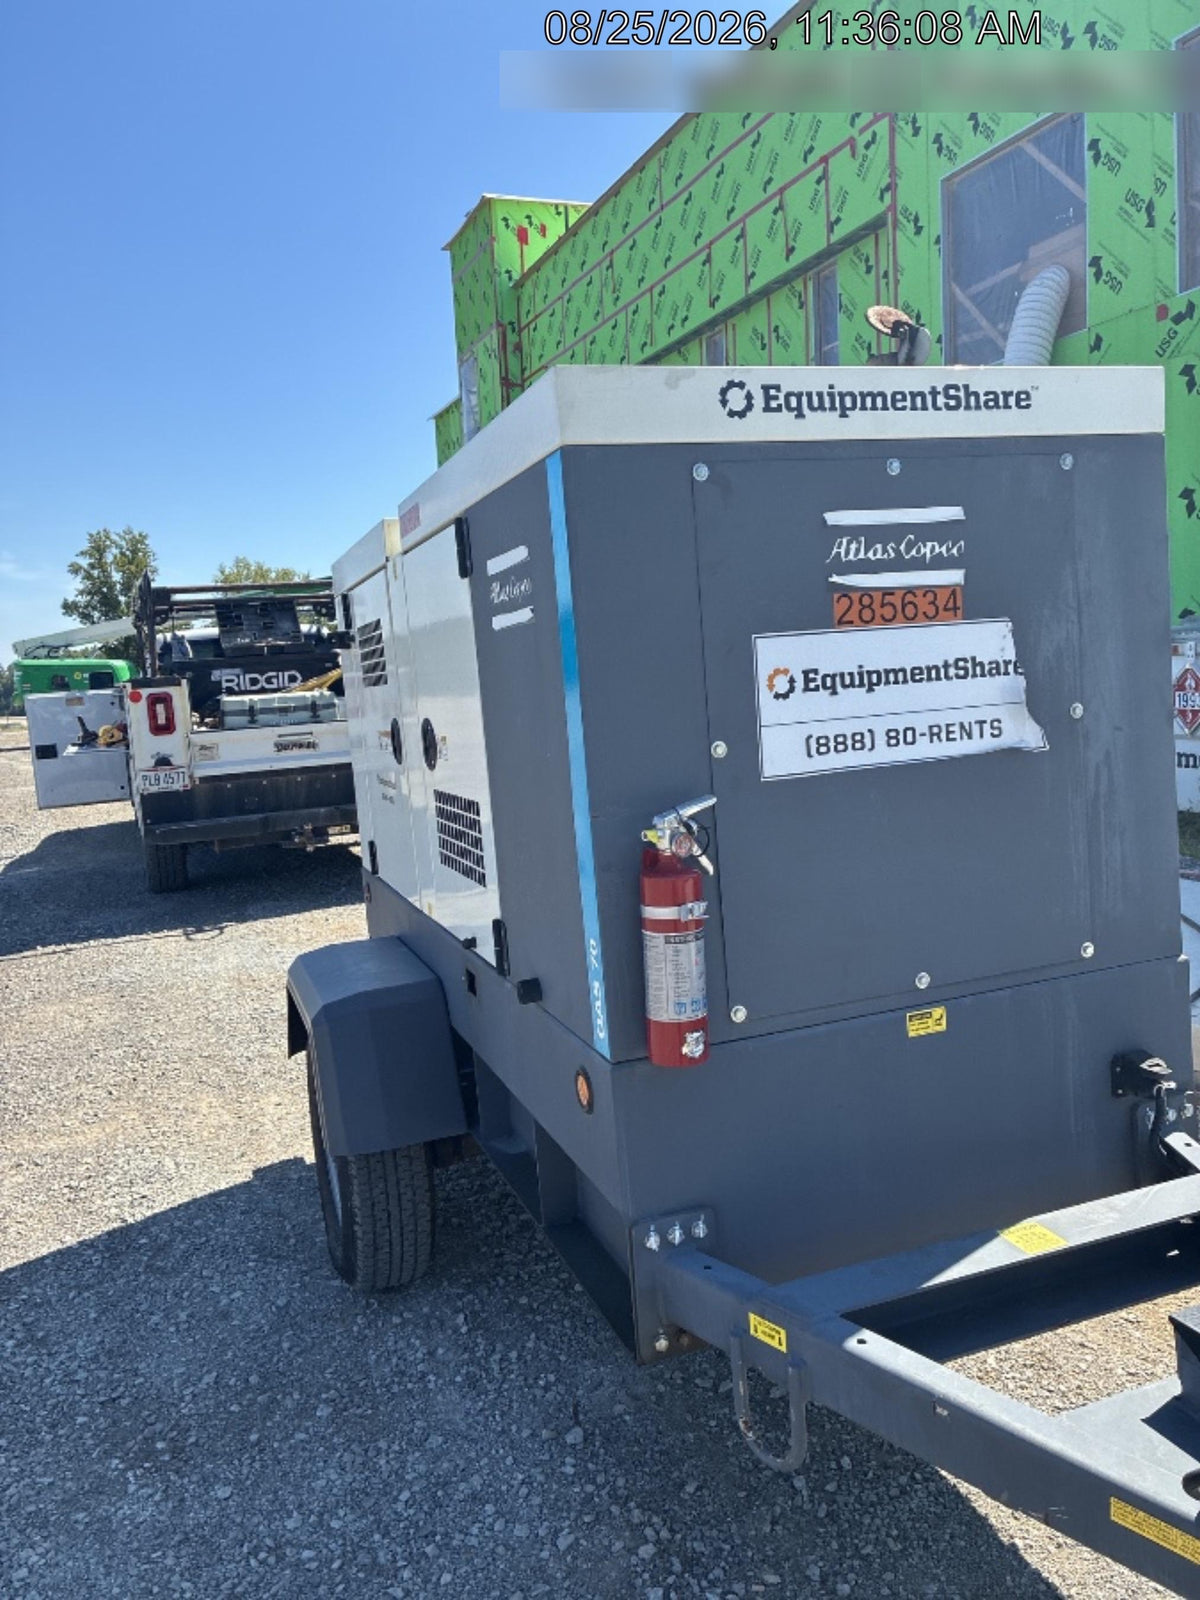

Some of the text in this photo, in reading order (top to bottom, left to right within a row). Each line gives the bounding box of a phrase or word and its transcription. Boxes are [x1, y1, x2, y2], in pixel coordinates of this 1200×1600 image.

[1125, 188, 1145, 213] USG
[1103, 270, 1123, 295] USG
[1155, 327, 1178, 358] USG
[761, 384, 1032, 418] EquipmentShare
[826, 537, 896, 563] Atlas
[836, 588, 961, 626] 285634
[222, 671, 302, 691] RIDGID
[806, 719, 1002, 758] (888) 80-RENTS
